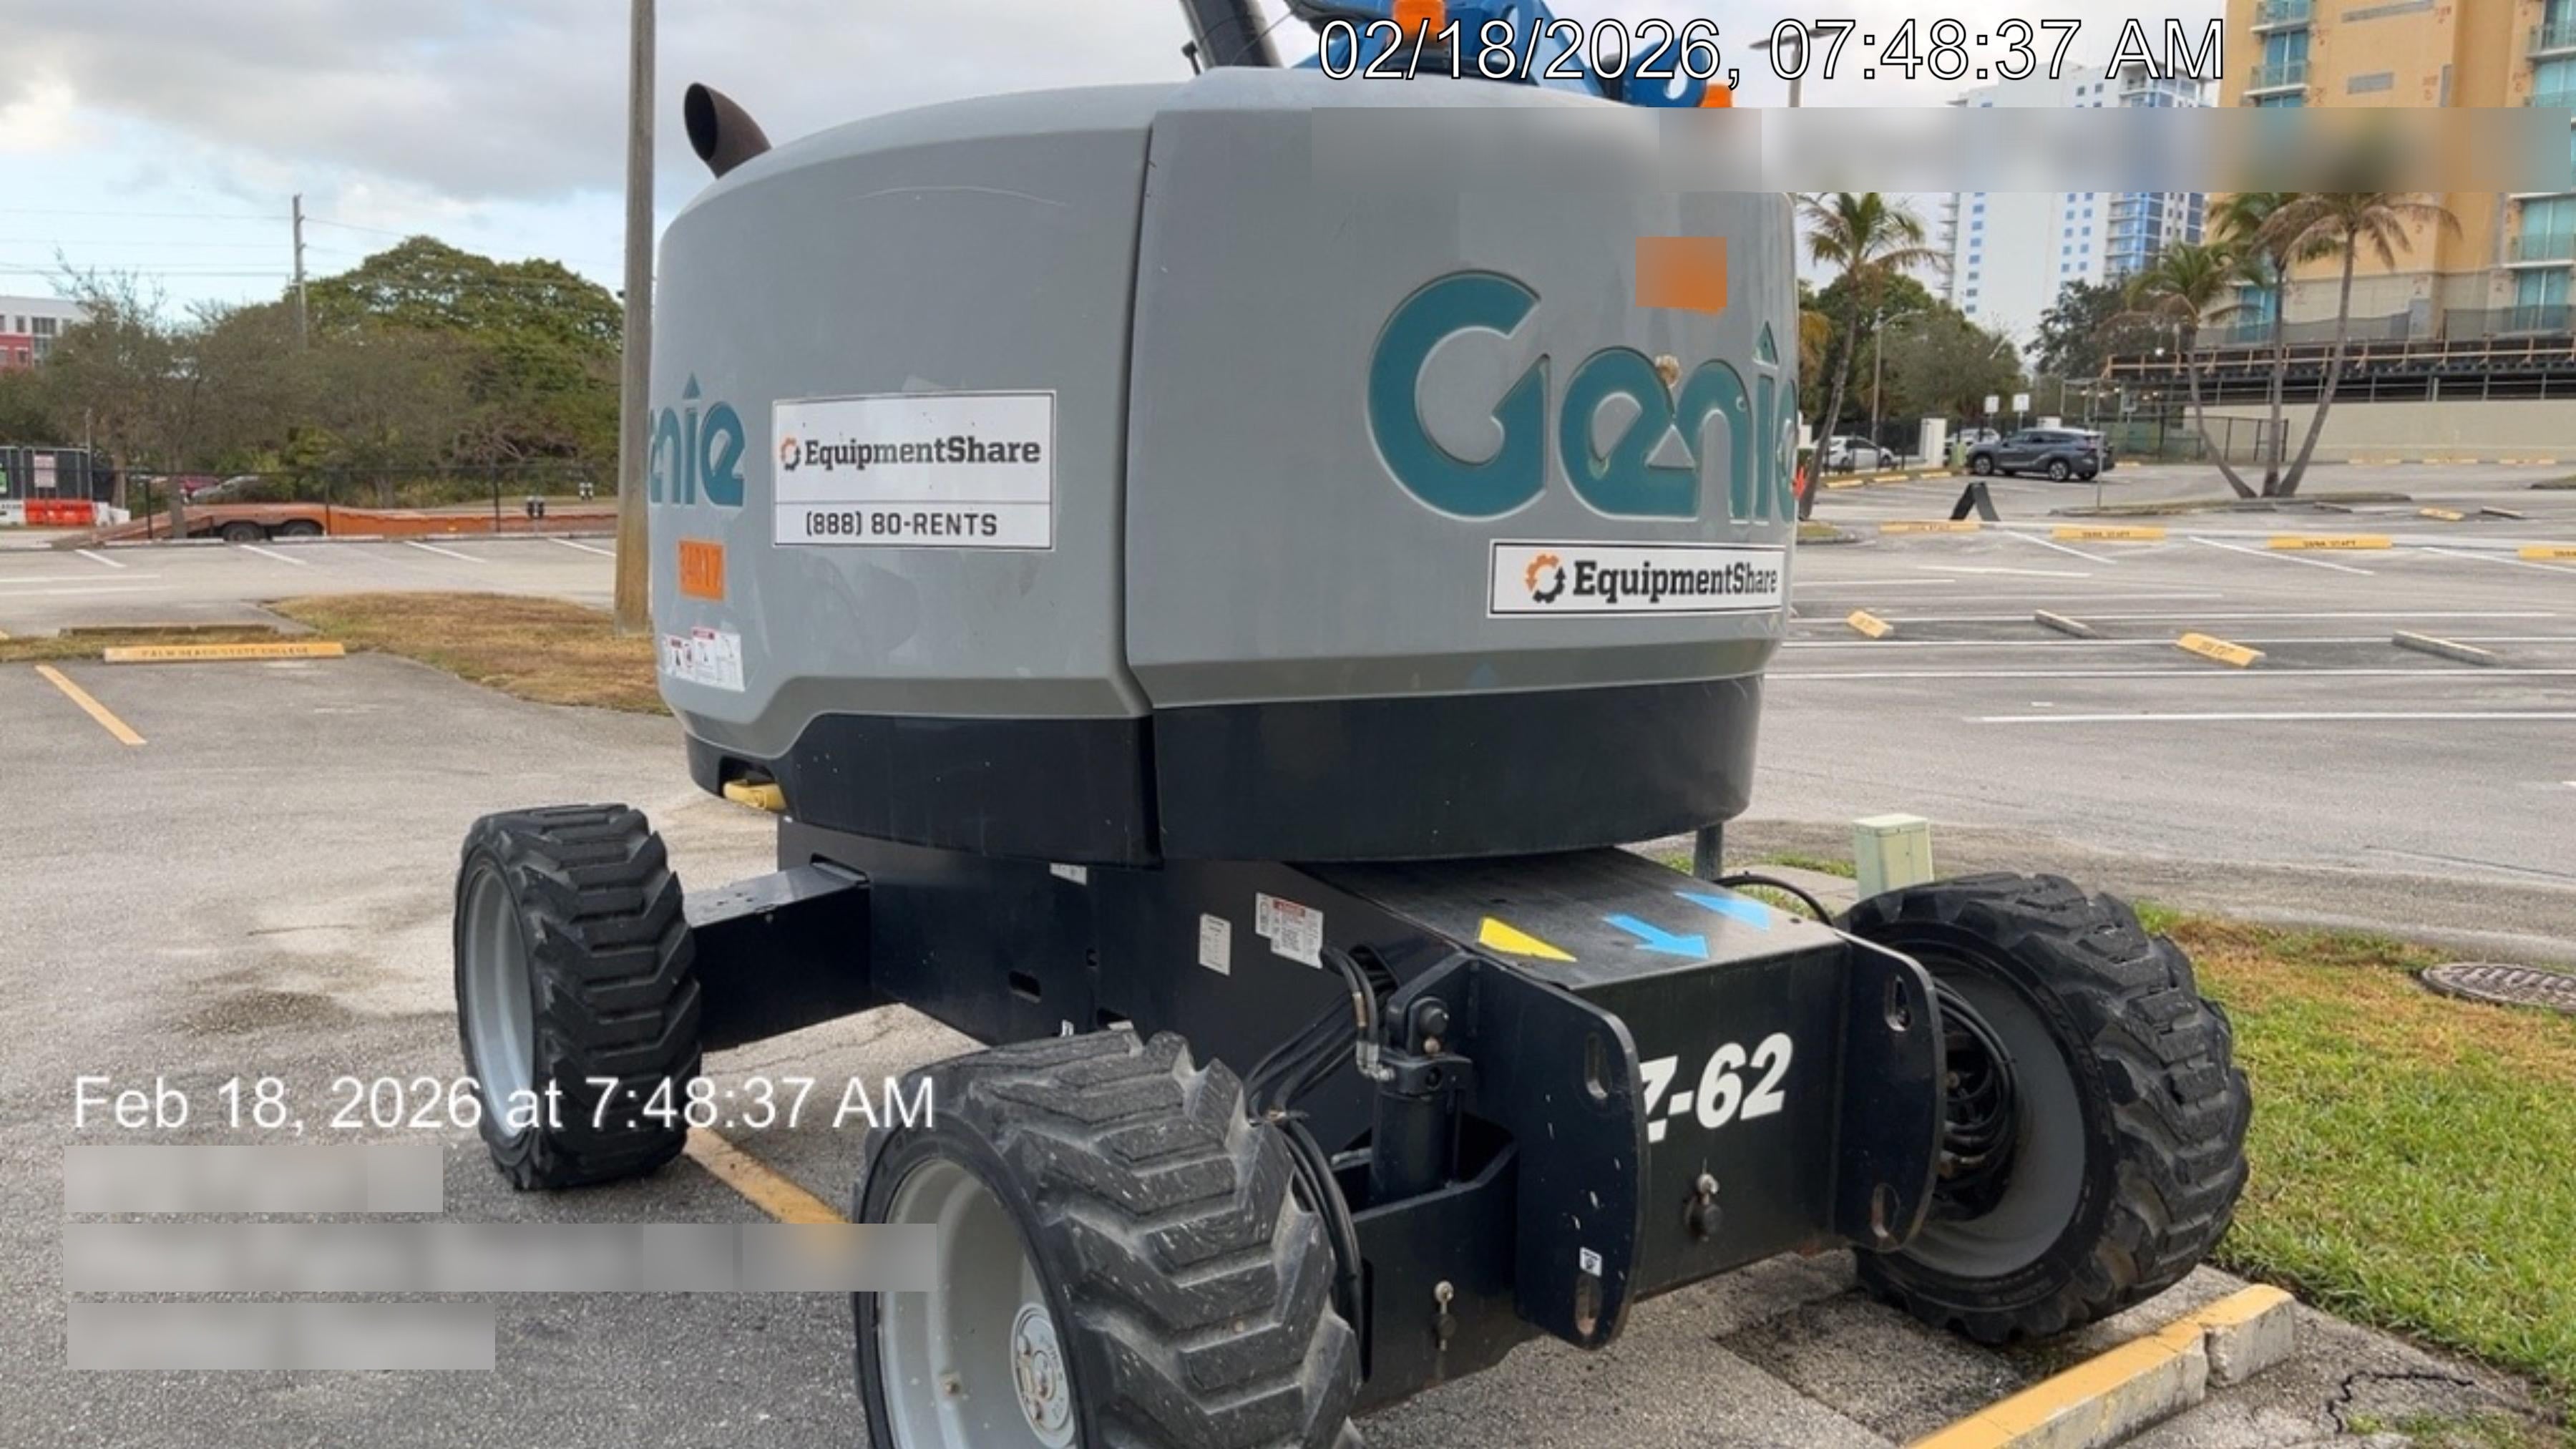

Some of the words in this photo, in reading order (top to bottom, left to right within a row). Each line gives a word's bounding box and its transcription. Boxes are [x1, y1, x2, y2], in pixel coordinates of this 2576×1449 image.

[1367, 270, 1798, 523] Genie
[650, 371, 745, 507] nie
[805, 436, 1041, 470] EquipmentShare
[806, 512, 863, 537] (888)
[871, 512, 997, 537] 80-RENTS
[1573, 560, 1777, 604] EquipmentShare
[1639, 1032, 1794, 1143] Z-62
